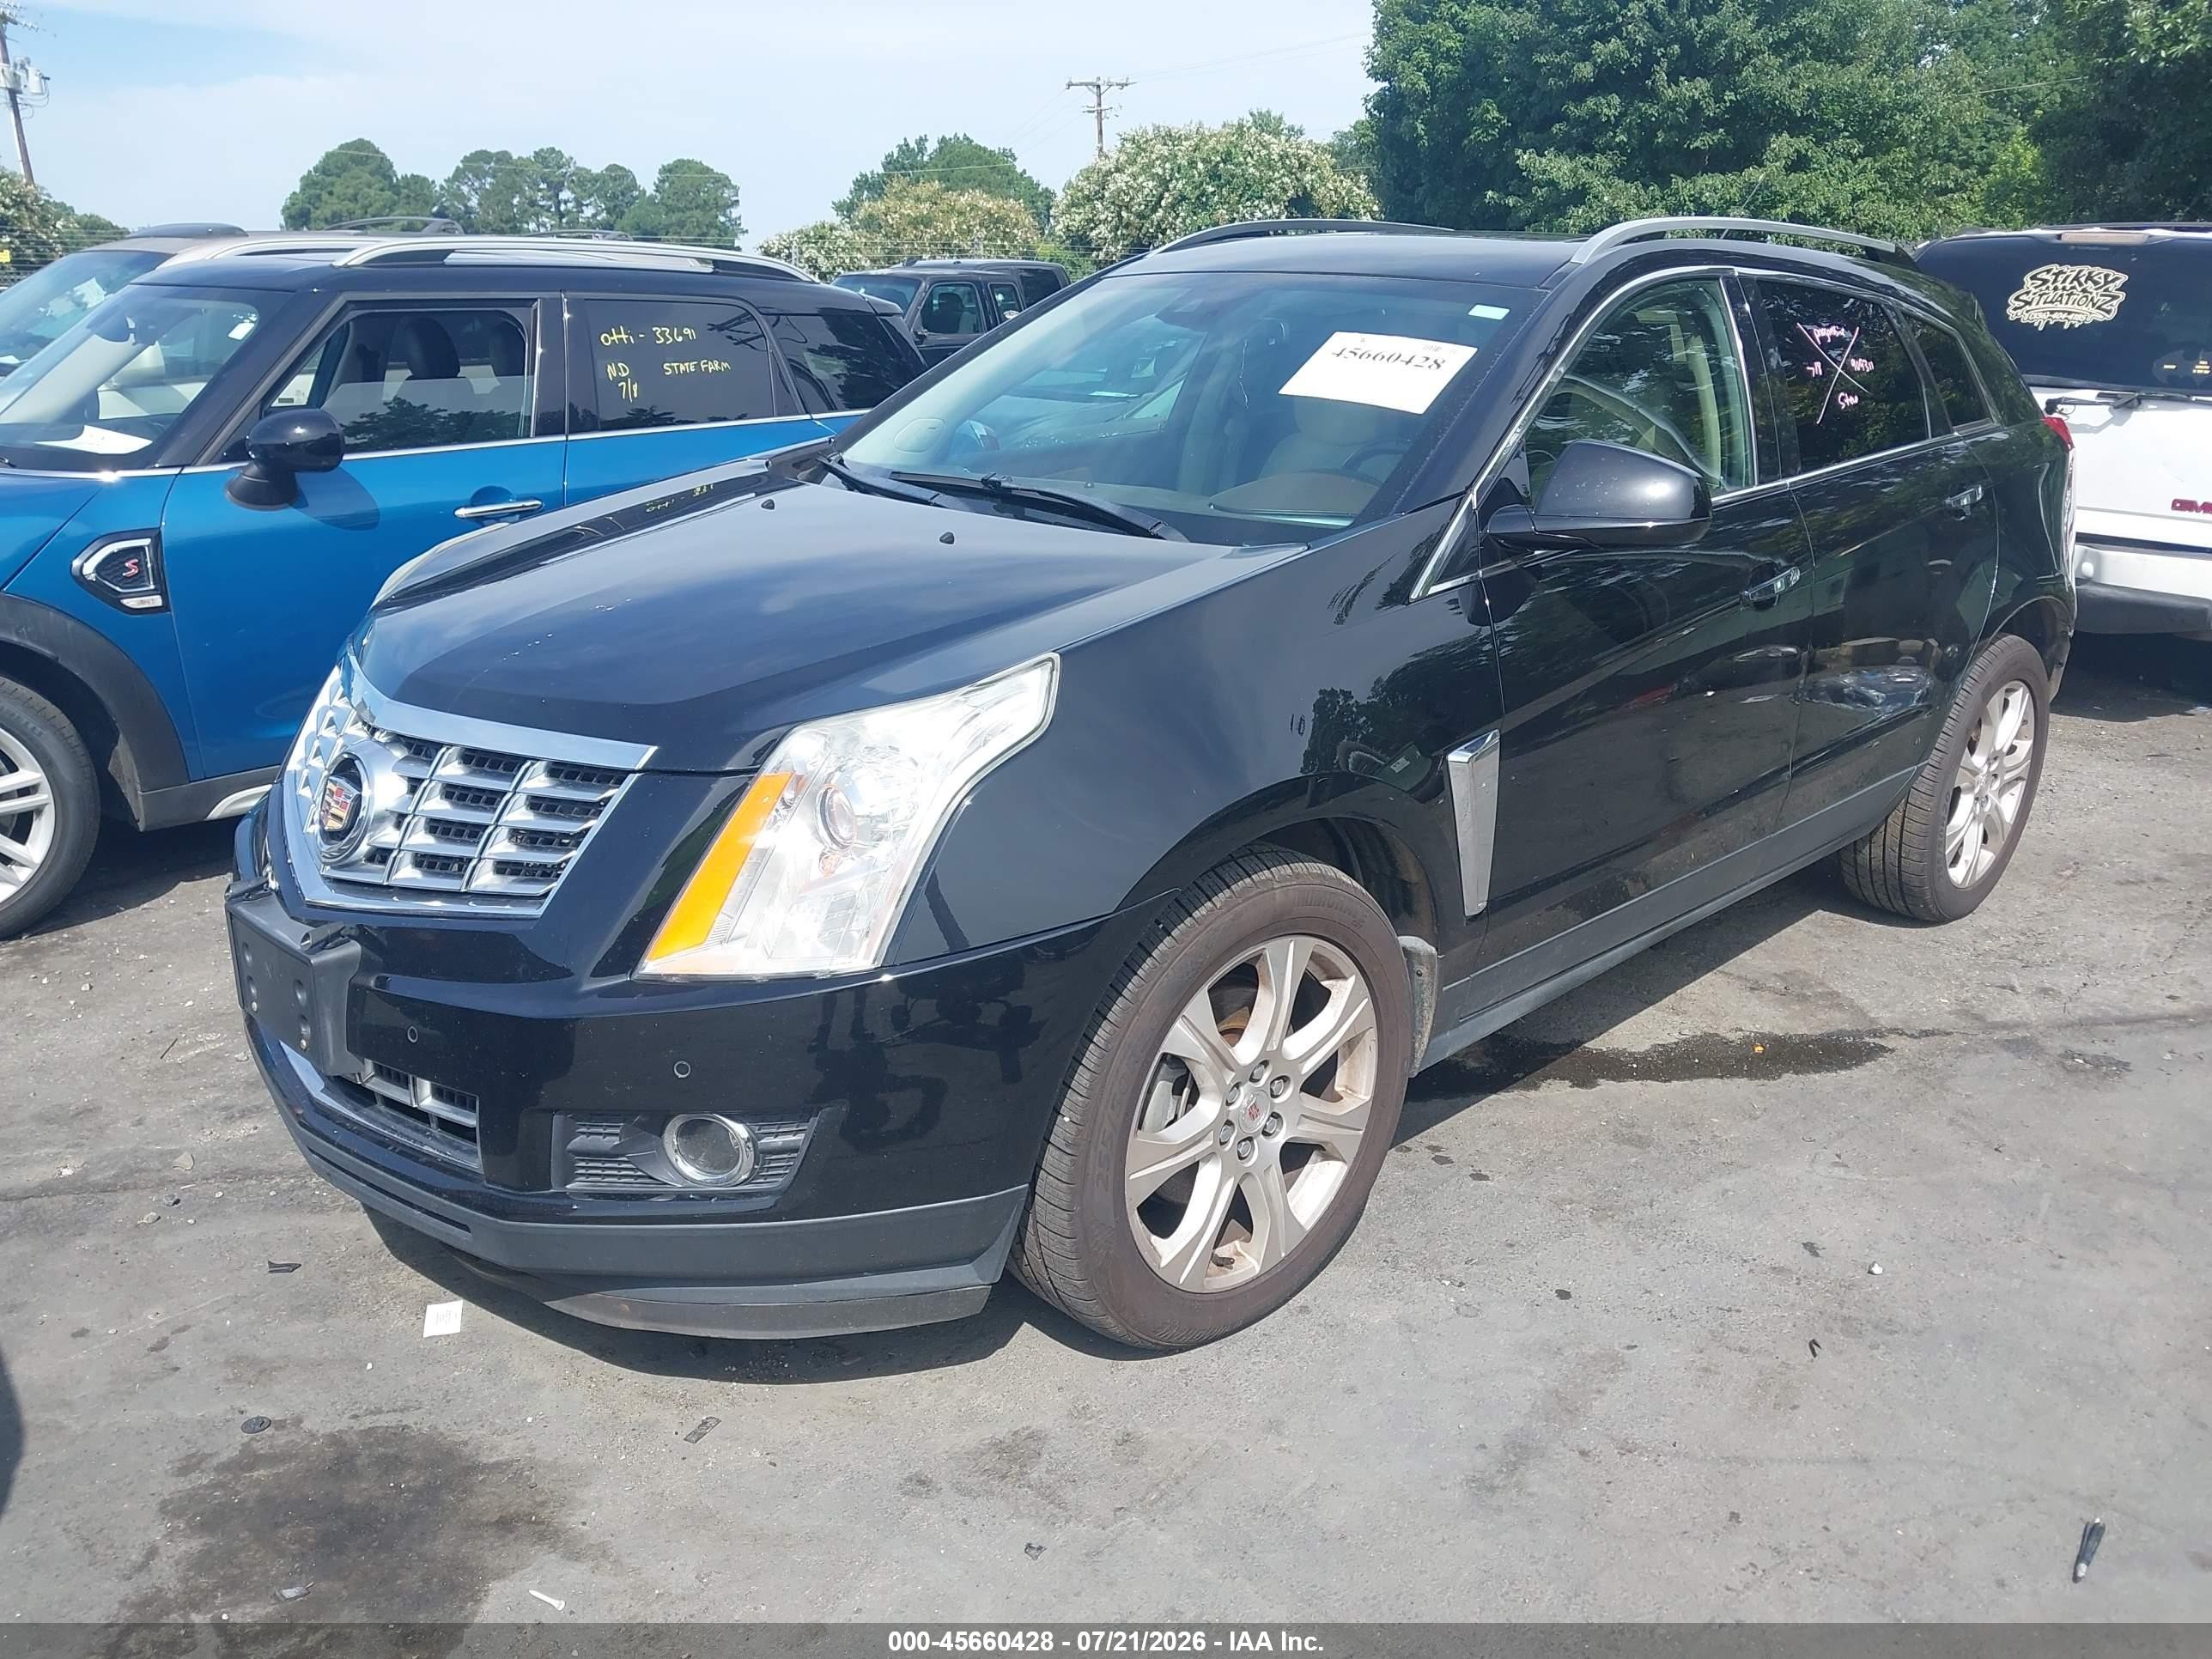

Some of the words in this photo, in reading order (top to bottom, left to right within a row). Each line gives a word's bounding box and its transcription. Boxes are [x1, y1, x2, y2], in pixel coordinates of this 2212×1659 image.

[653, 326, 696, 344] 33691
[663, 361, 698, 375] STATE
[700, 359, 731, 374] FARM
[1333, 346, 1446, 370] 45660428
[2171, 498, 2212, 514] GM
[123, 558, 139, 577] S
